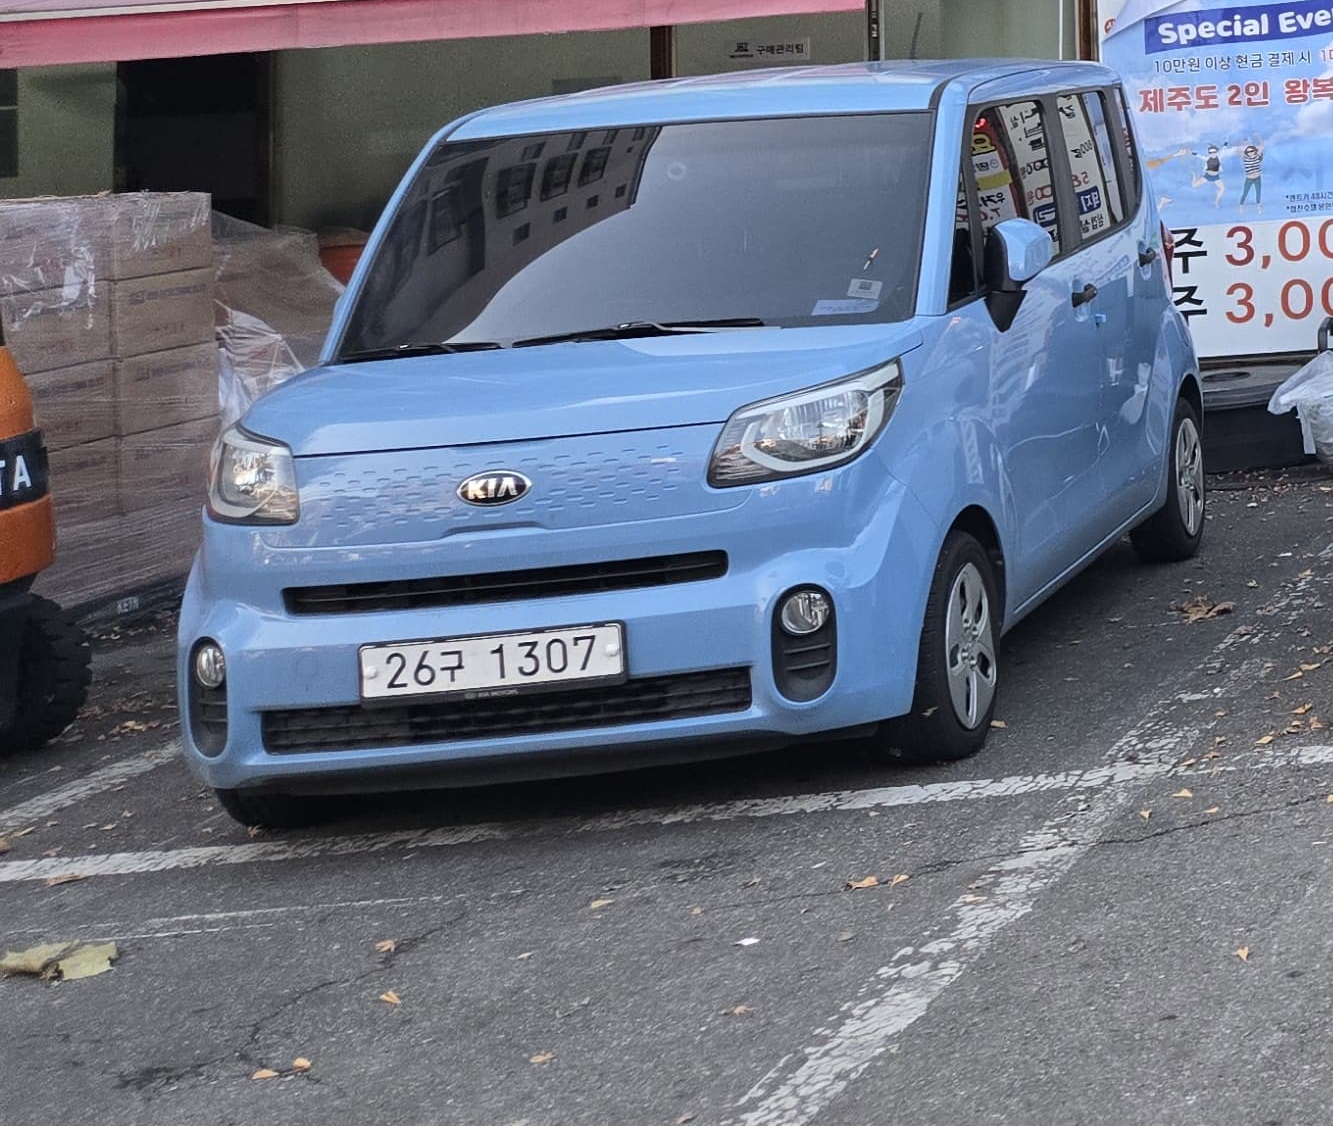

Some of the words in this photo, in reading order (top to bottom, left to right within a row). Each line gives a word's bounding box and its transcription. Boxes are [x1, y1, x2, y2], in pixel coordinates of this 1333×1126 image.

[1158, 16, 1269, 45] Special
[1154, 57, 1200, 74] 10만원
[1205, 56, 1231, 71] 이상
[1235, 54, 1263, 70] 현금
[1268, 50, 1295, 66] 결제
[1299, 50, 1312, 65] 시
[1139, 84, 1219, 114] 제주도
[1227, 81, 1269, 107] 2인
[466, 478, 517, 500] KIA
[385, 650, 465, 689] 26구
[490, 635, 597, 680] 1307
